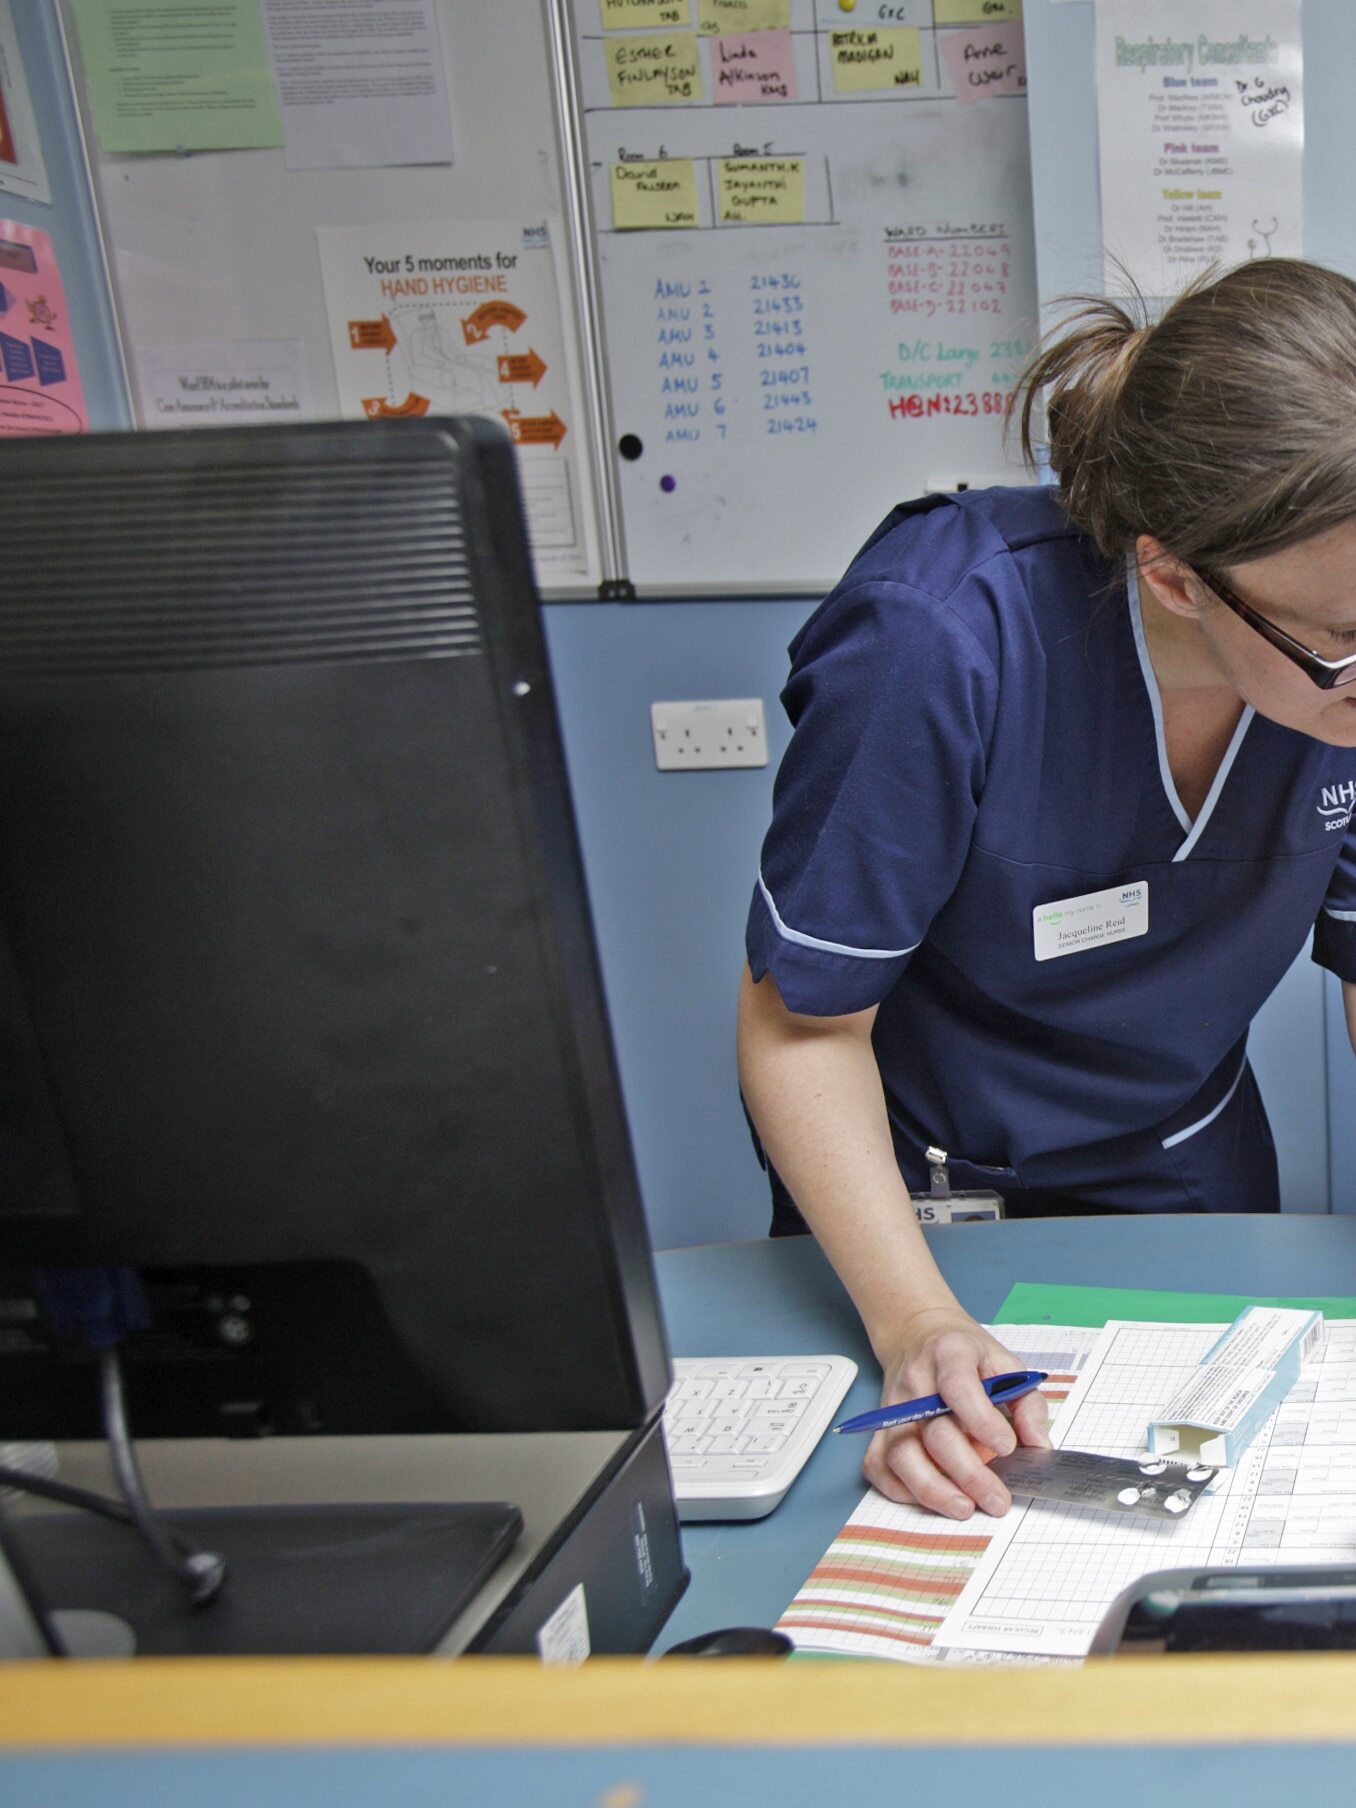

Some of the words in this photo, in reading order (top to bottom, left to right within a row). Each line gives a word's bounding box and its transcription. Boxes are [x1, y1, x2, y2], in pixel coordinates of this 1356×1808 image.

[615, 45, 676, 64] ESTHER
[719, 41, 757, 62] Linda
[837, 46, 893, 63] MADIGAN
[1115, 36, 1194, 73] Respiratory
[617, 66, 696, 86] FINLAYSON
[1163, 76, 1187, 88] Blue
[1190, 77, 1218, 87] team
[1164, 143, 1188, 153] Pink
[1191, 144, 1219, 153] team
[615, 166, 658, 180] David
[732, 195, 778, 207] GUPTA
[1161, 188, 1194, 199] Yellow
[1197, 189, 1222, 199] team
[522, 227, 547, 238] NHS
[363, 256, 401, 275] Your
[405, 255, 415, 272] 5
[418, 254, 492, 272] moments
[496, 252, 519, 269] for
[380, 278, 428, 297] HAND
[432, 275, 508, 294] HYGIENE
[654, 279, 692, 299] AMU
[699, 280, 711, 294] 1
[657, 307, 690, 321] AMU
[703, 303, 715, 318] 2
[351, 328, 361, 343] 1
[658, 329, 692, 345] AMU
[704, 324, 715, 340] 3
[659, 352, 695, 369] AMU
[708, 348, 719, 362] 4
[757, 343, 806, 358] 21404
[898, 340, 930, 361] D/C
[500, 362, 510, 377] 4
[661, 377, 699, 394] AMU
[711, 373, 723, 390] 5
[761, 366, 809, 386] 21407
[367, 401, 380, 416] 3
[664, 403, 700, 419] AMU
[713, 398, 726, 415] 6
[666, 429, 700, 442] AMU
[716, 423, 727, 439] 7
[767, 417, 818, 434] 21424
[1122, 889, 1142, 900] NHS
[1058, 925, 1103, 941] Jacqueline
[1105, 917, 1126, 929] Reid
[1058, 940, 1081, 949] SENIOR
[1081, 934, 1105, 944] CHARGE
[1106, 927, 1126, 937] NURSE
[882, 1420, 897, 1428] Start
[967, 1622, 1002, 1633] THERAPY
[1003, 1626, 1040, 1635] REGULAR
